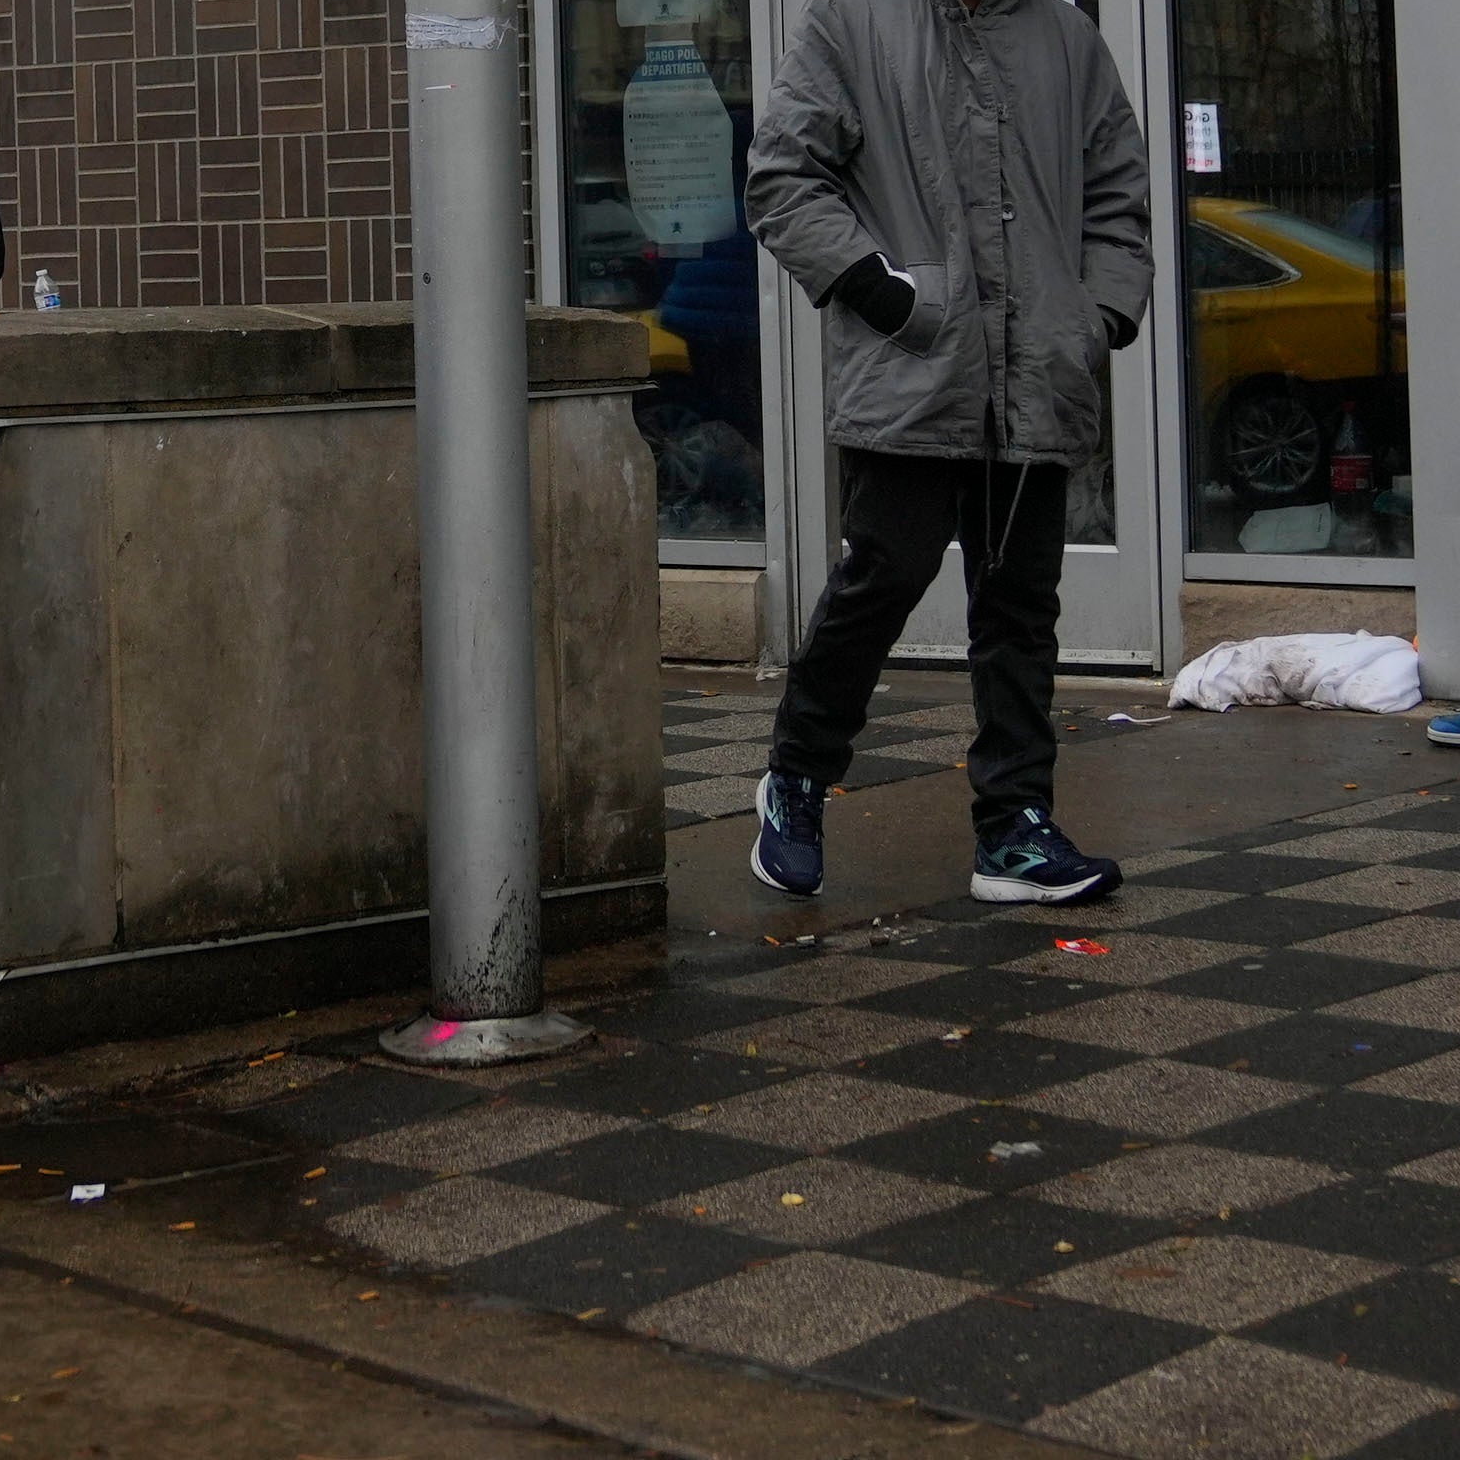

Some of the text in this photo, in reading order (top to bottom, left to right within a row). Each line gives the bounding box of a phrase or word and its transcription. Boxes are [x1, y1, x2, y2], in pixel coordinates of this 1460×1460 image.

[645, 48, 702, 63] ICAGO POL
[641, 61, 707, 77] DEPARTMENT
